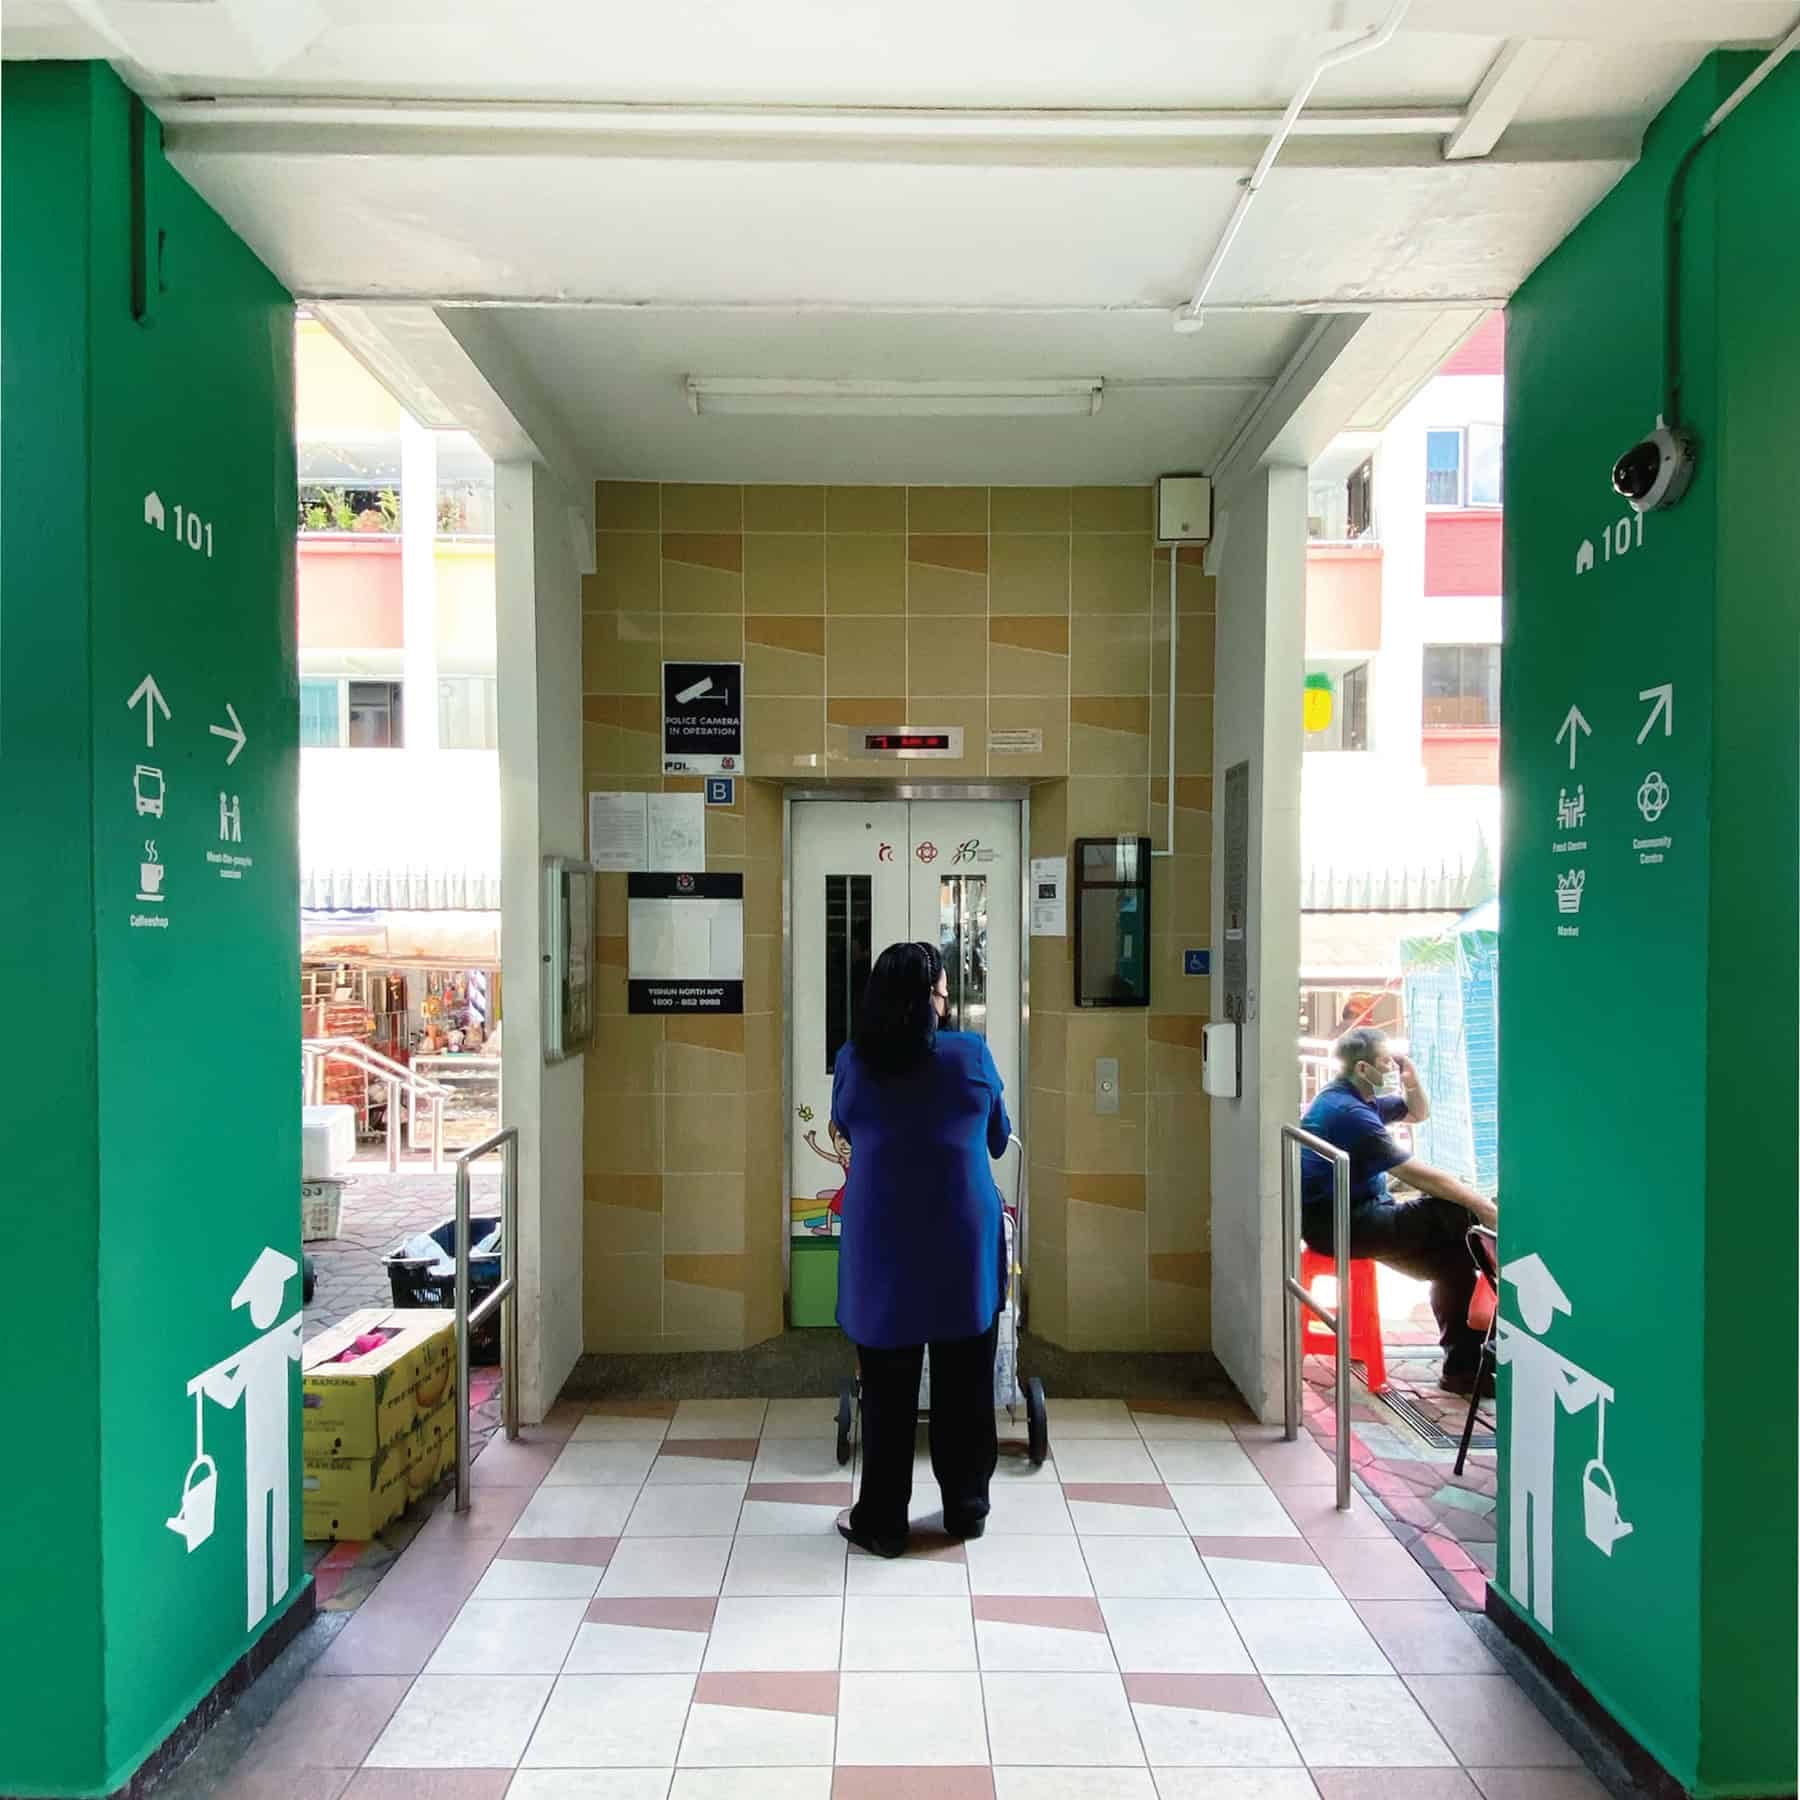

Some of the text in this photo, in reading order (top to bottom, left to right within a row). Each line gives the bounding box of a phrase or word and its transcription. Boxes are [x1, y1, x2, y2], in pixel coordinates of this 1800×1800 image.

[173, 504, 212, 558] 101
[1602, 510, 1644, 562] 101
[665, 716, 740, 726] POLICE CAMERA
[669, 727, 736, 736] IN OPERATION
[713, 783, 727, 800] B
[1632, 835, 1672, 849] Community
[1639, 852, 1664, 865] Centre
[679, 987, 706, 996] NORTH
